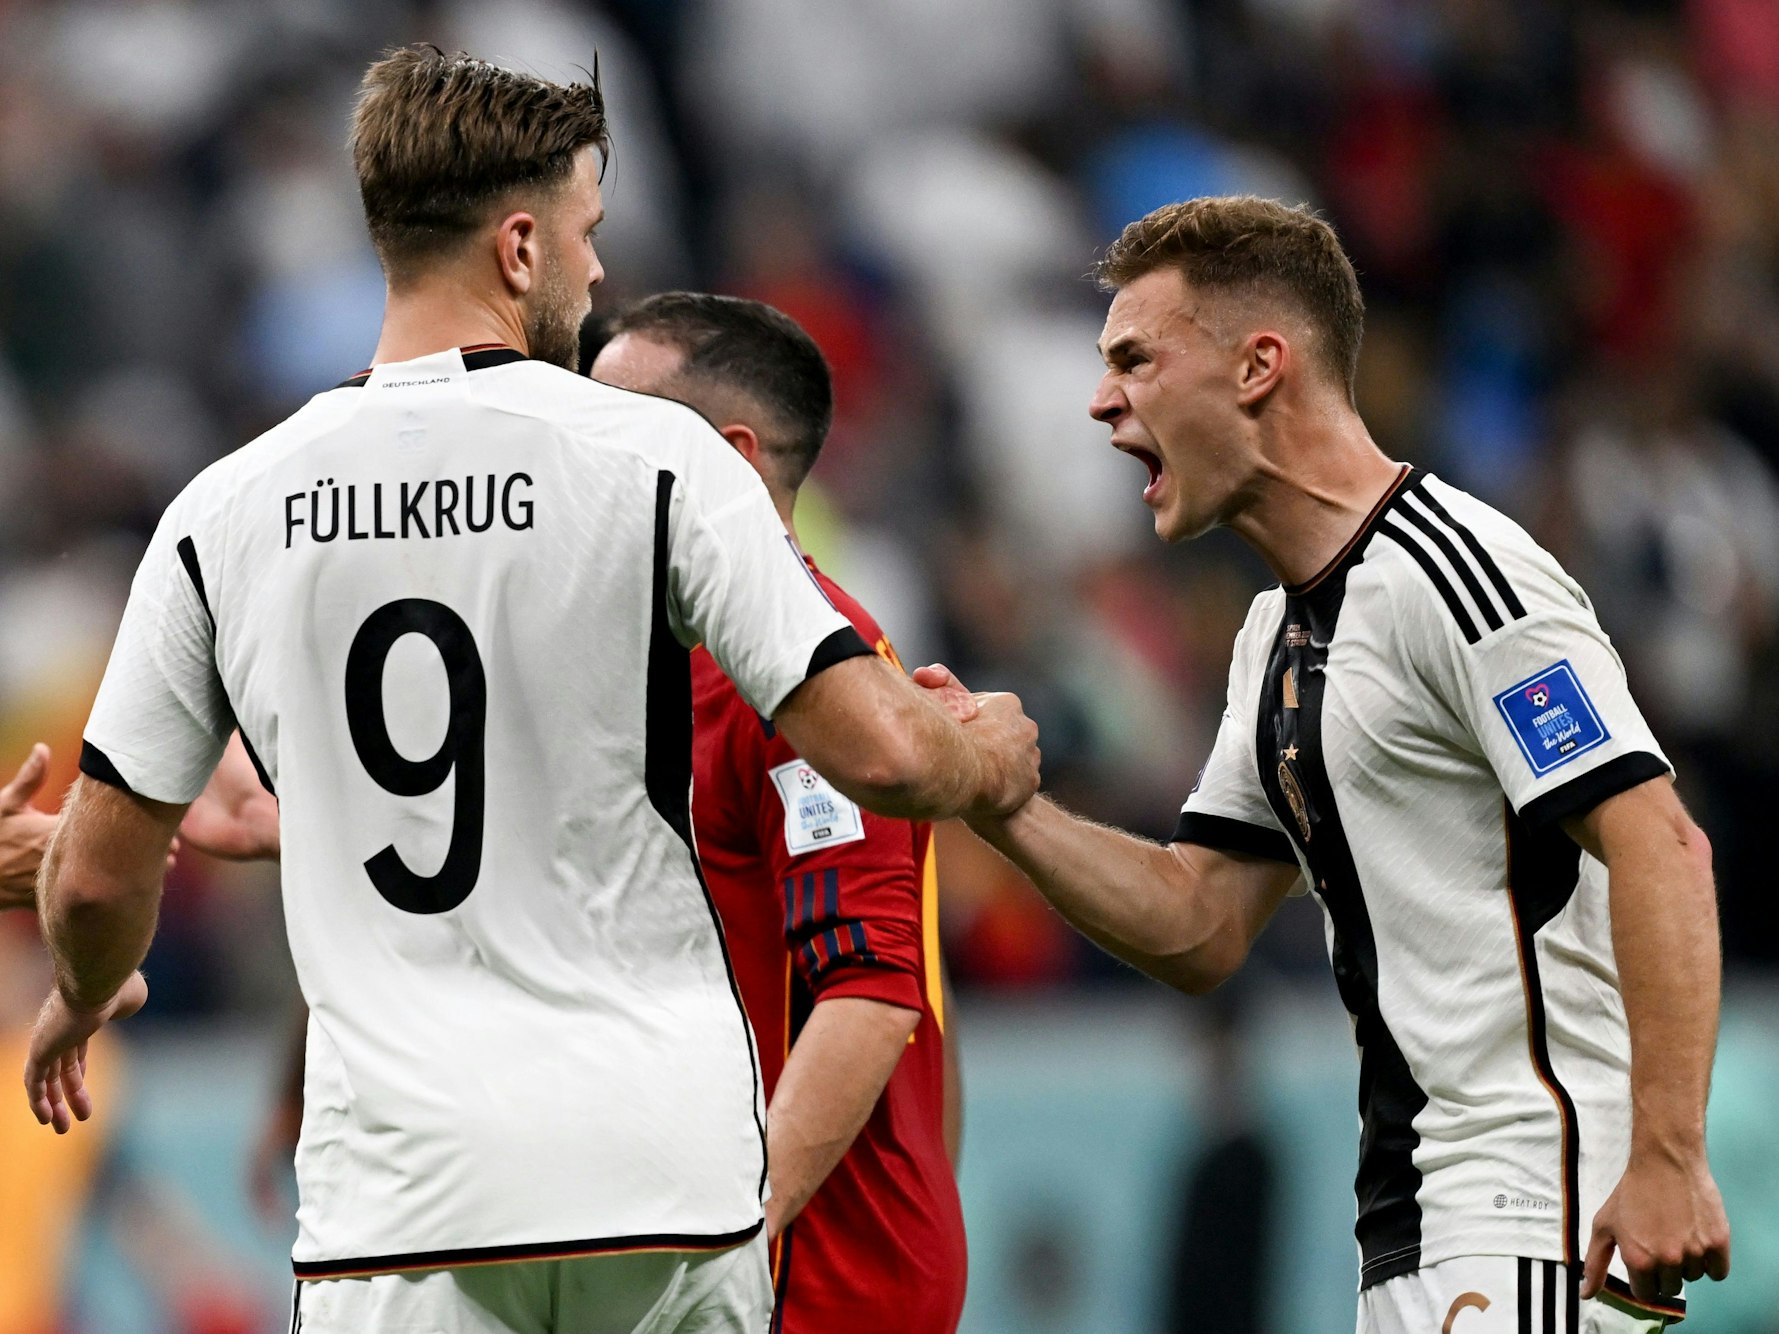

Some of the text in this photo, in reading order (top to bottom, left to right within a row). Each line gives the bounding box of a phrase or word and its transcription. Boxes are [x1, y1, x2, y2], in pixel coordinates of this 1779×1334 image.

[382, 377, 451, 388] DEUTSCHLAND
[285, 472, 534, 549] FÜLLKRUG
[1532, 703, 1568, 728] FOOTBALL
[1537, 712, 1574, 739] UNITES
[1542, 721, 1581, 750] the World
[1560, 741, 1576, 754] FIFA
[344, 597, 487, 915] 9
[799, 801, 834, 819] UNITES
